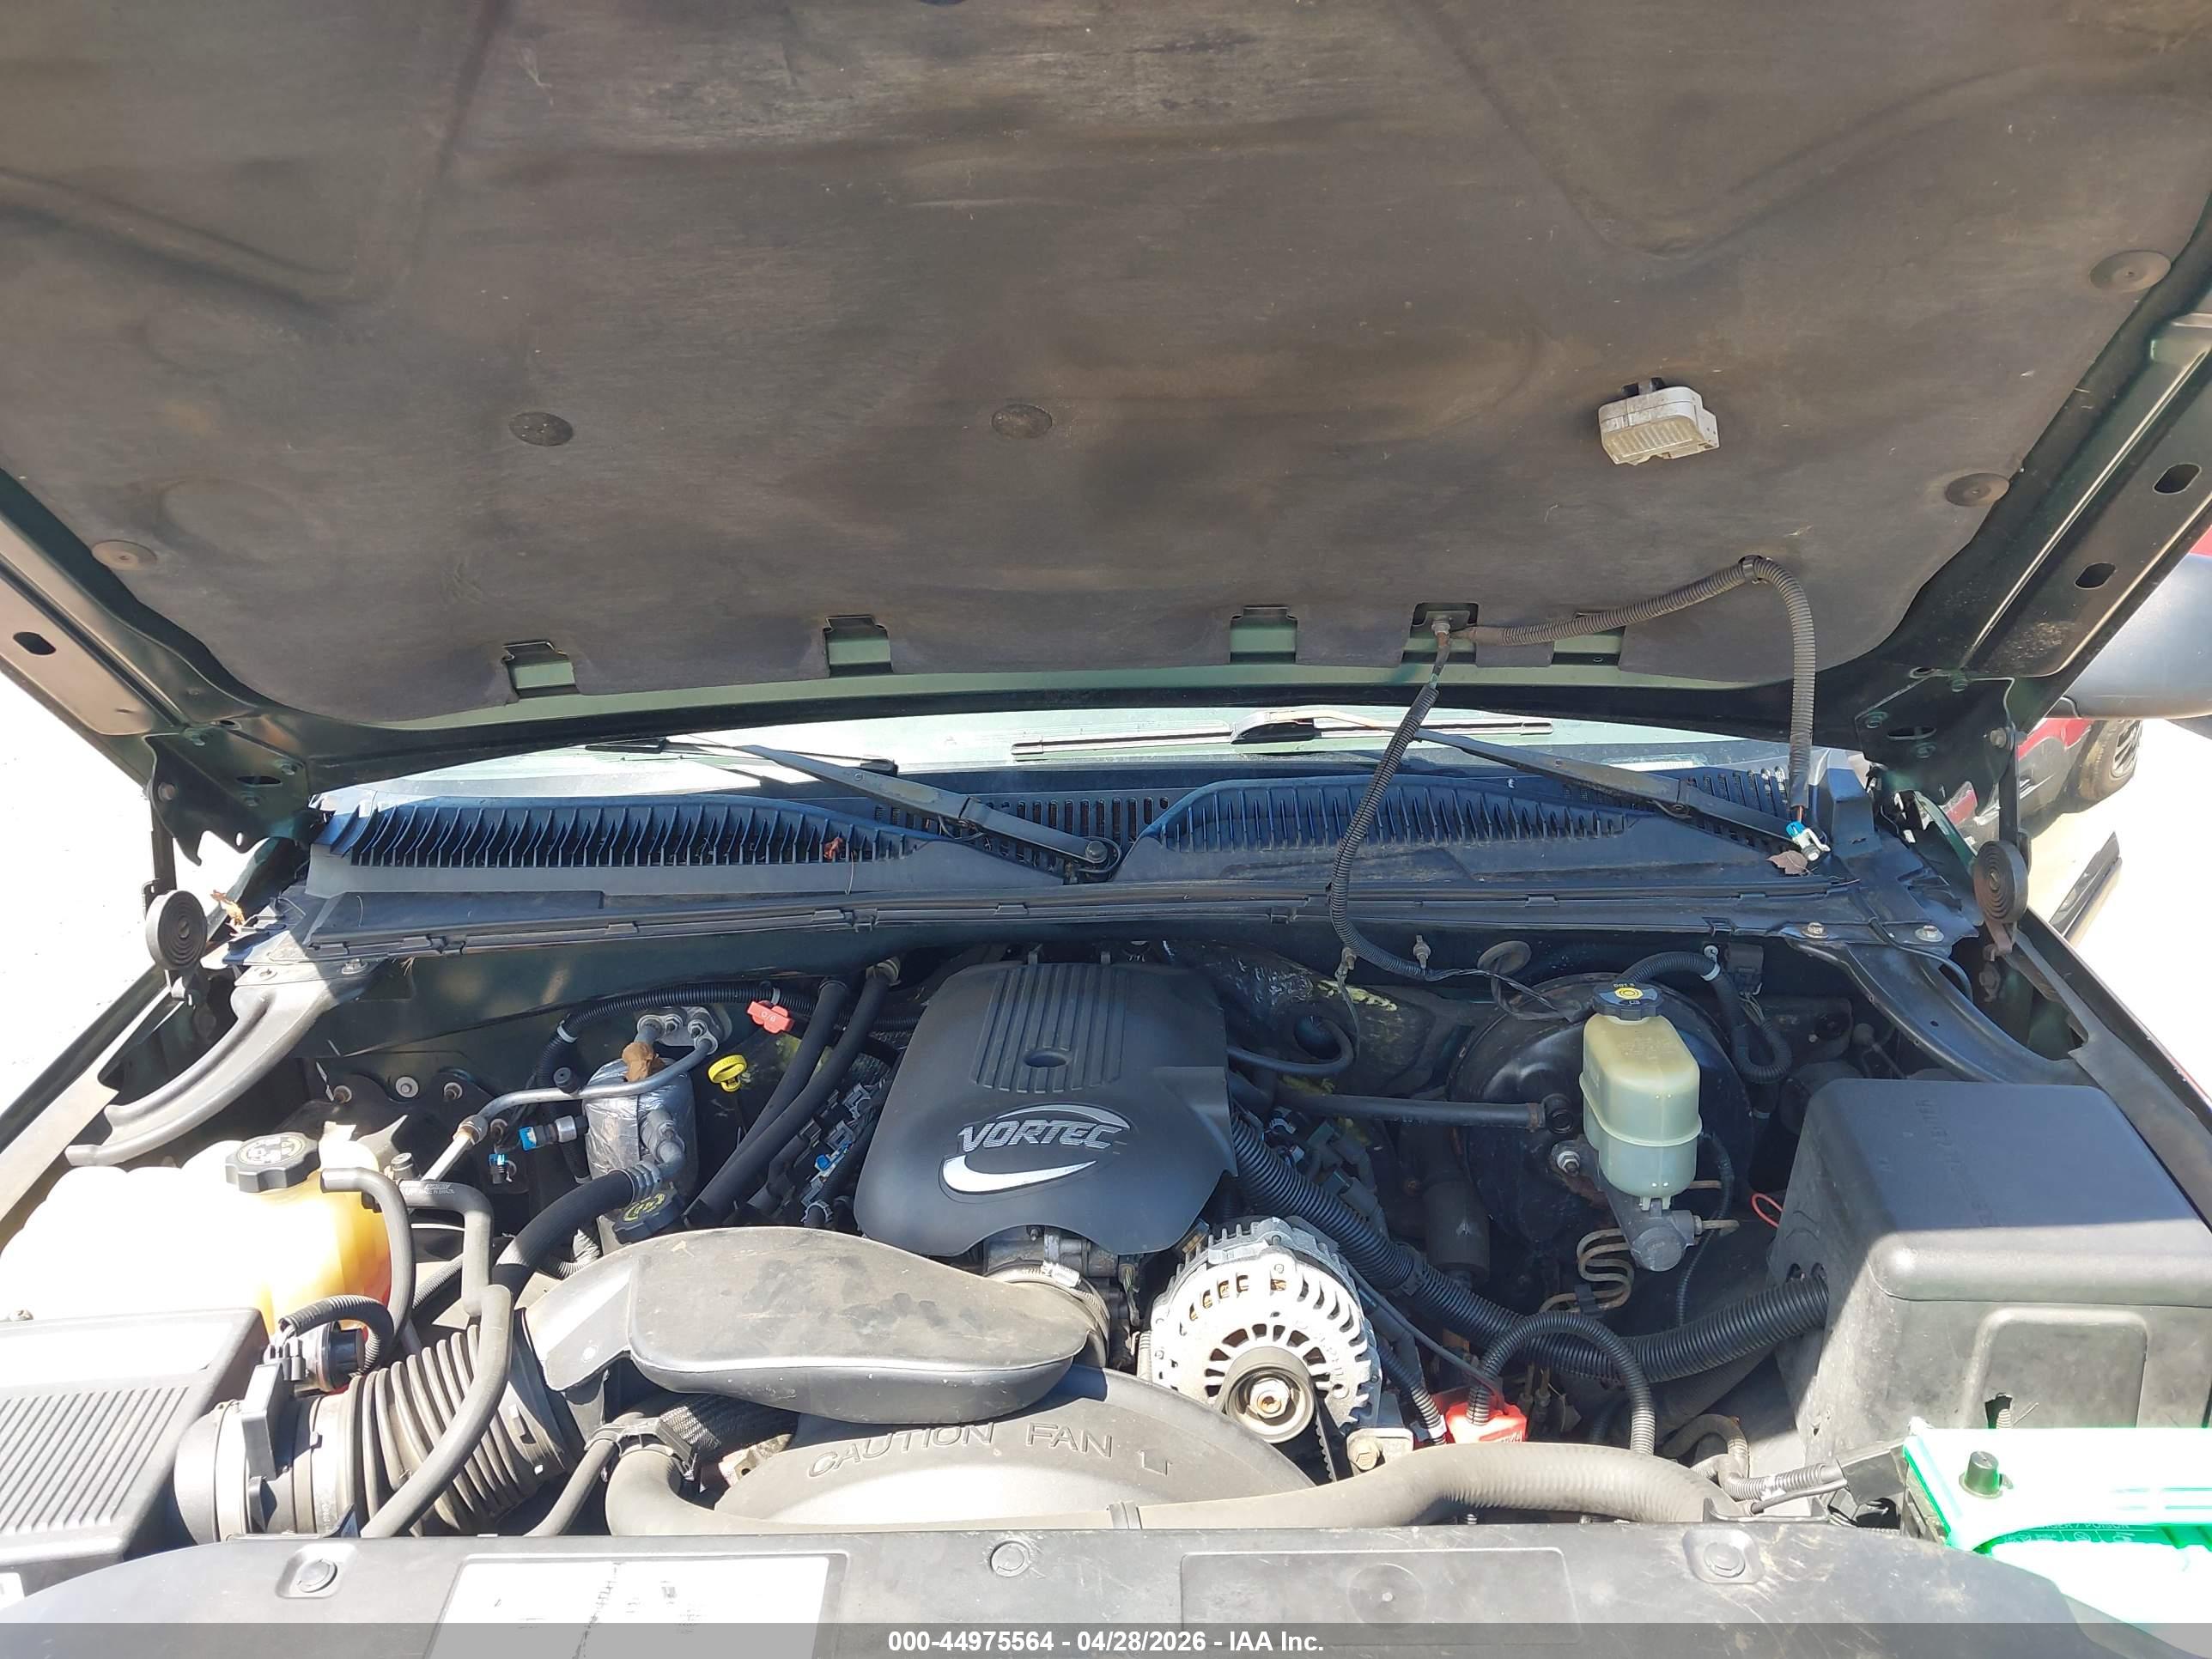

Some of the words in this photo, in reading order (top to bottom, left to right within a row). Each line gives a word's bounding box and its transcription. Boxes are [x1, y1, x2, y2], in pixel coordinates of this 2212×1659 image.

[957, 1119, 1122, 1152] VORTEC
[808, 1422, 994, 1477] CAUTION
[1026, 1422, 1113, 1459] FAN
